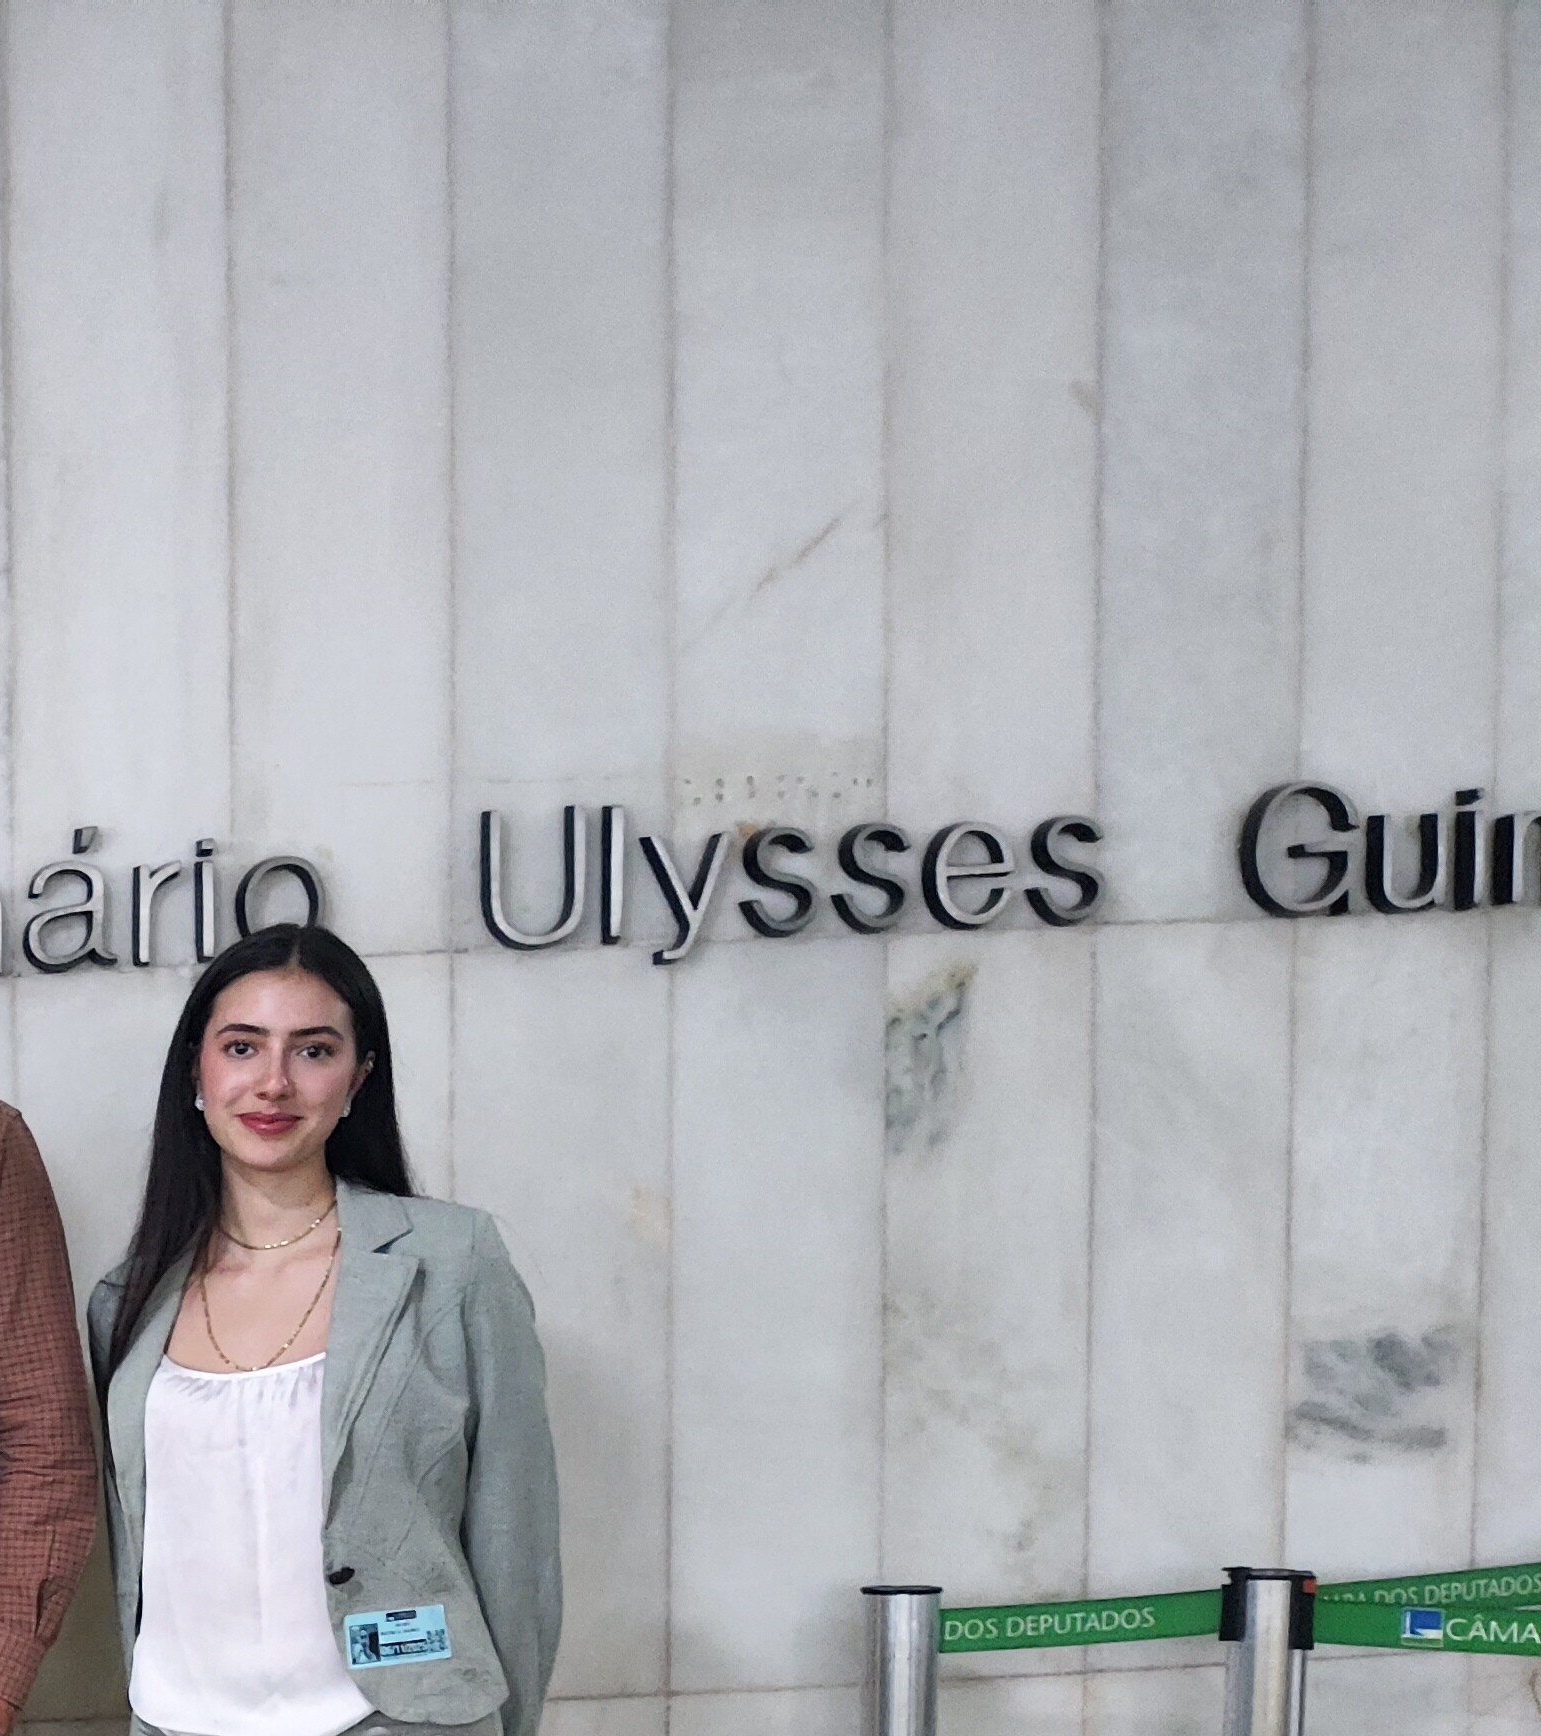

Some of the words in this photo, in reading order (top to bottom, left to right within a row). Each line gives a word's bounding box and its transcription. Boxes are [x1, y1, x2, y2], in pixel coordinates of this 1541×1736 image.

[478, 803, 1105, 966] Ulysses
[944, 1617, 999, 1641] DOS
[1006, 1606, 1157, 1638] DEPUTADOS
